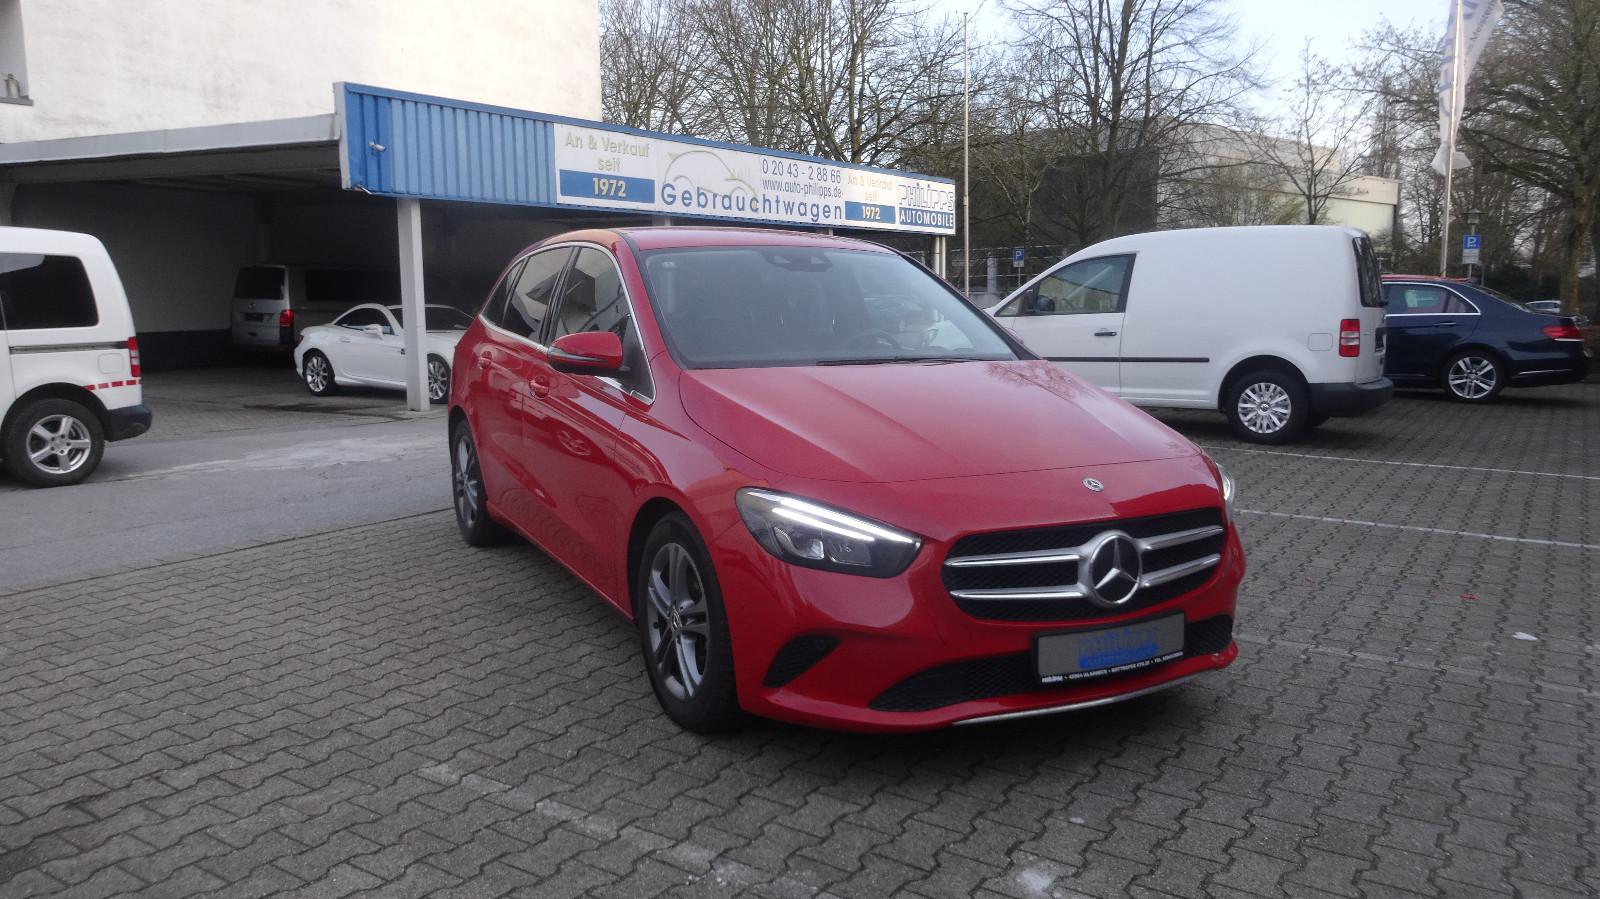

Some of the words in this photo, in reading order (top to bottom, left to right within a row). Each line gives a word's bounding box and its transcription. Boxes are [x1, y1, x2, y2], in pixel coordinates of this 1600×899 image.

[565, 132, 583, 149] An
[588, 135, 598, 150] &
[602, 138, 650, 158] Verkauf
[598, 157, 621, 173] seit
[772, 160, 784, 176] 20
[787, 163, 799, 178] 43
[817, 168, 828, 182] 88
[830, 170, 841, 184] 66
[593, 177, 627, 198] 1972
[762, 180, 842, 200] www.auto-philipps.de
[661, 183, 842, 222] Gebrauchtwagen
[862, 205, 881, 220] 1972
[899, 210, 954, 228] AUTOMOBILE
[1467, 236, 1477, 248] P
[1015, 250, 1022, 260] P
